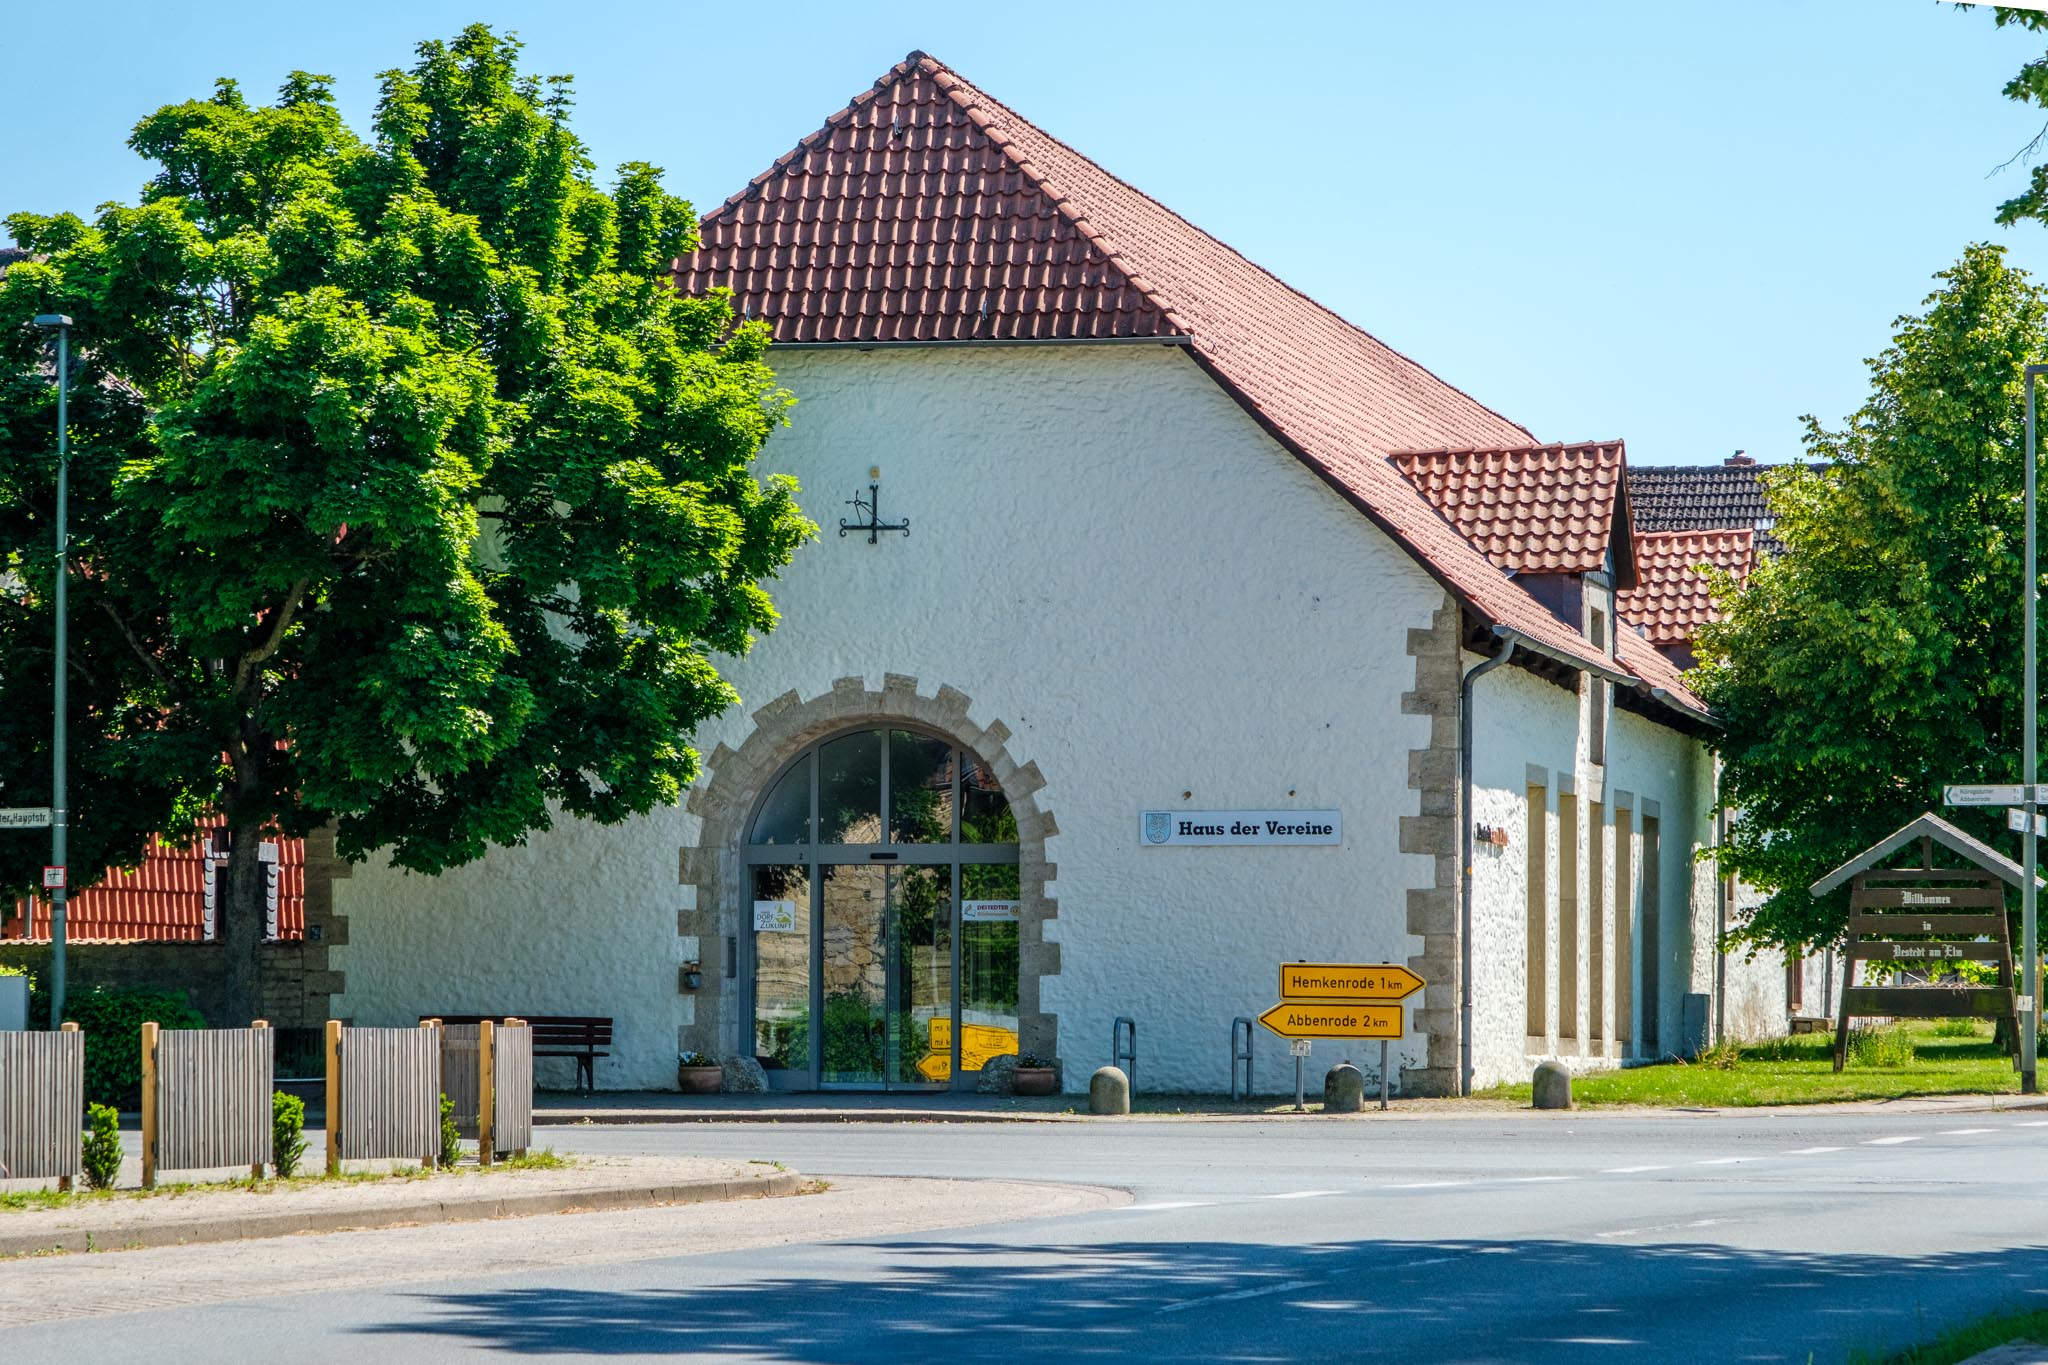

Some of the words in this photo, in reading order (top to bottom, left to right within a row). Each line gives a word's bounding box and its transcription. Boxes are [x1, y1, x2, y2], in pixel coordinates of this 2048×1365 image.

[1179, 821, 1225, 836] Haus
[1230, 821, 1260, 836] der
[1265, 821, 1333, 836] Vereine
[1902, 891, 1951, 907] Willkommen
[1923, 921, 1932, 931] in
[1893, 944, 1926, 960] Destedt
[1929, 949, 1941, 958] am
[1943, 944, 1963, 960] Elm
[1292, 976, 1375, 989] Hemkenrode
[1381, 978, 1385, 989] 1
[1388, 981, 1403, 990] km
[1287, 1014, 1358, 1027] Abbenrode
[1363, 1015, 1371, 1027] 2
[1373, 1018, 1389, 1028] km
